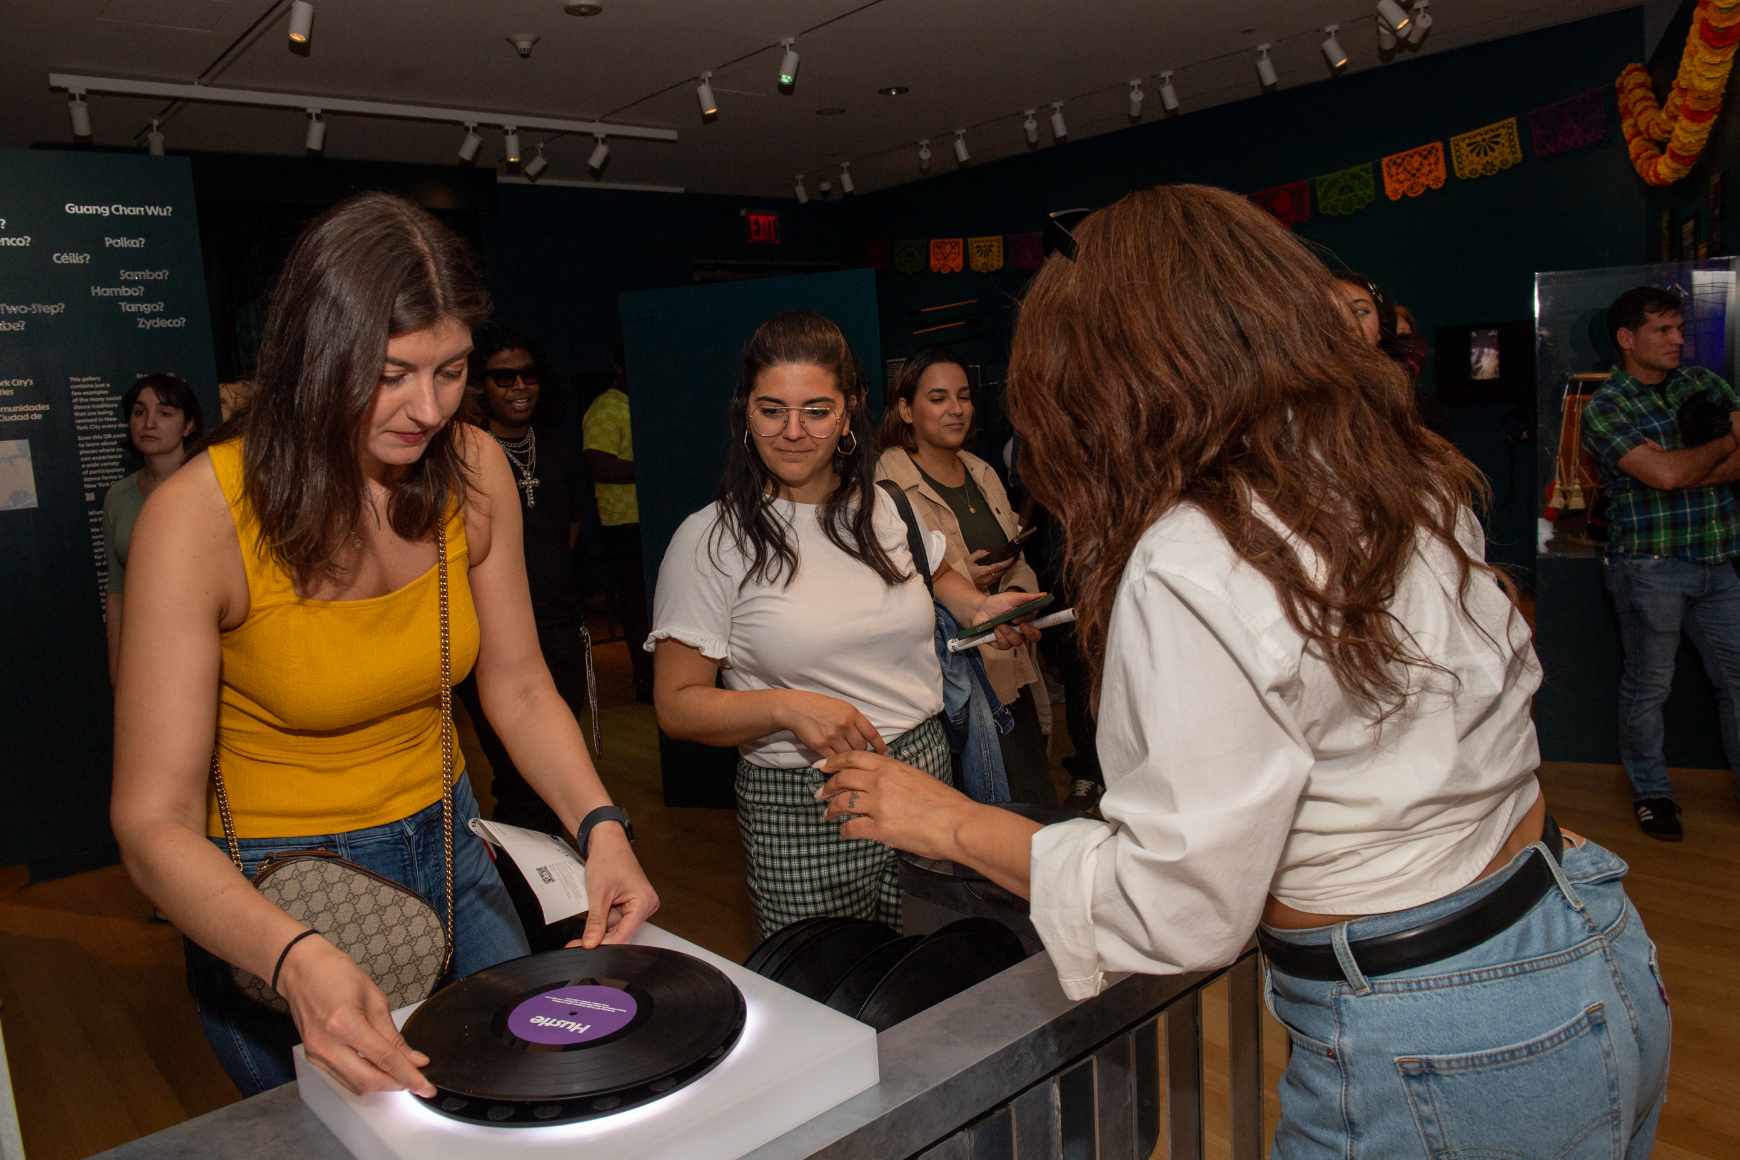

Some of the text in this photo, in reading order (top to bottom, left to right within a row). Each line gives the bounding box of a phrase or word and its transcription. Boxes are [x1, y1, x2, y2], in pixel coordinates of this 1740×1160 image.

[65, 203, 172, 216] Guang Chan Wu?
[750, 215, 775, 240] EXIT
[105, 237, 146, 248] Polka?
[120, 269, 169, 280] Samba?
[91, 286, 144, 296] Hambo?
[0, 303, 65, 315] Two-Step?
[119, 302, 164, 313] Tango?
[137, 317, 186, 329] Zydeco?
[530, 1016, 591, 1034] Hustle
